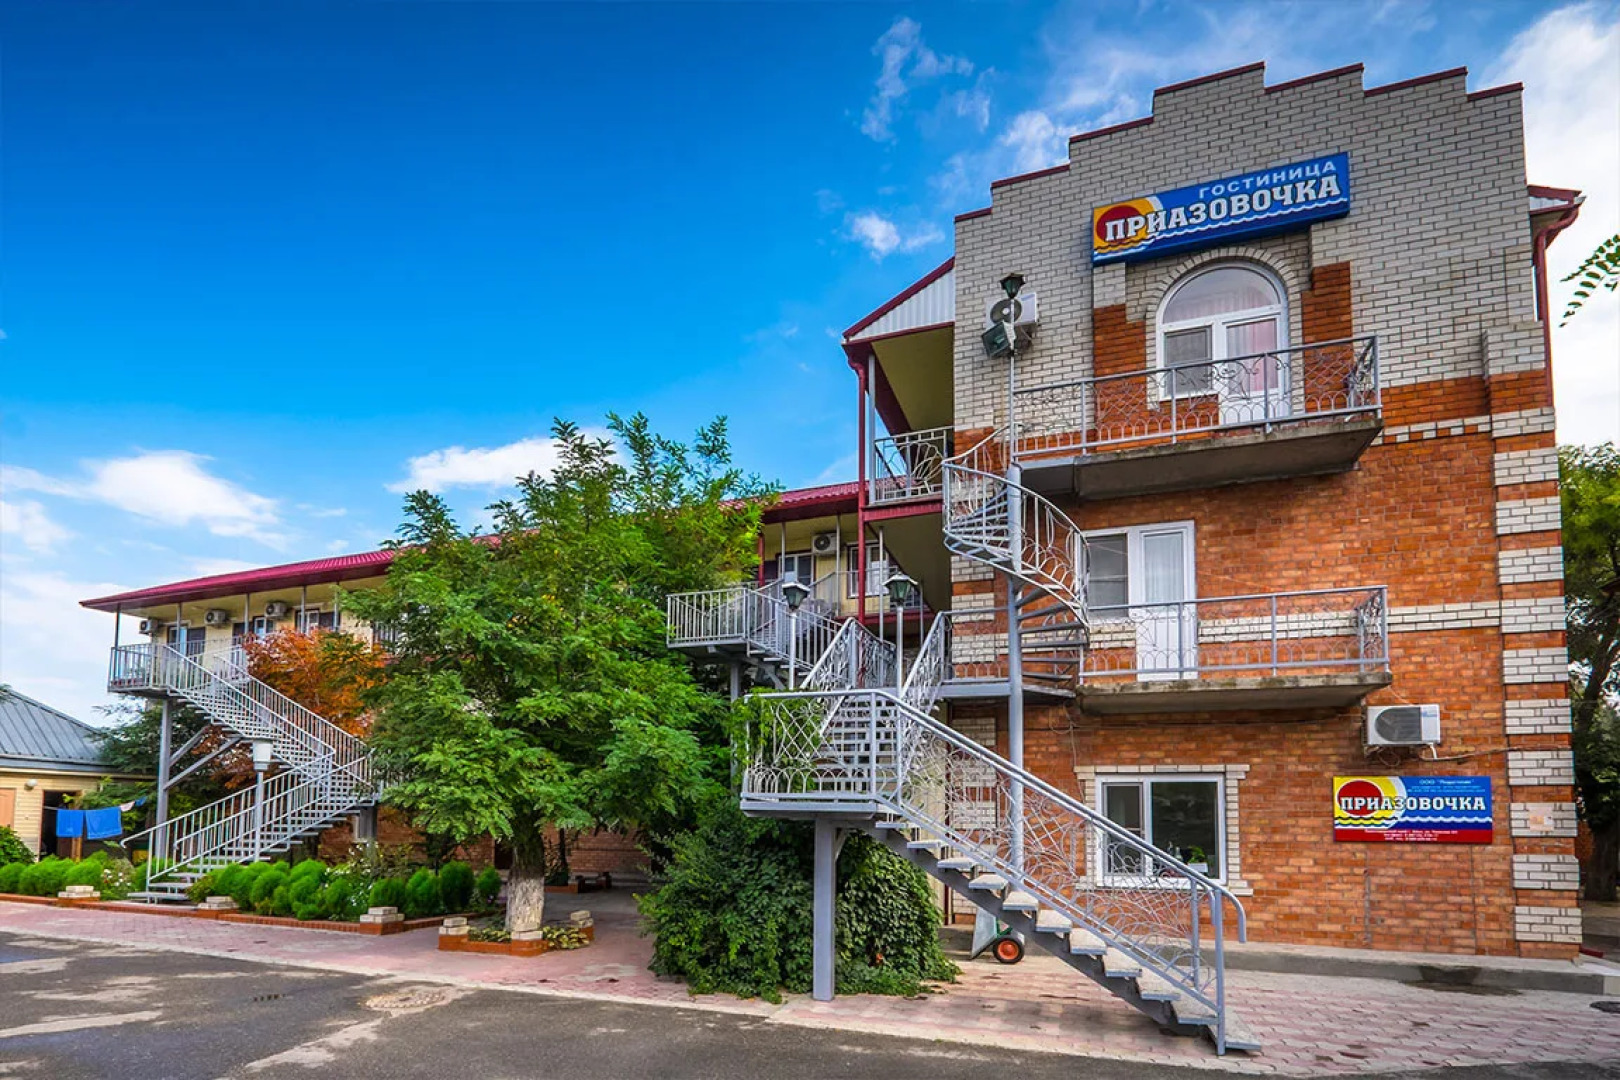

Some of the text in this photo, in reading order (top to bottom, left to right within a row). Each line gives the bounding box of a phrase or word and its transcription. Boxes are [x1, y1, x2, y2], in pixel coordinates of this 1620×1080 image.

[1199, 161, 1337, 198] ГОСТИНИЦА
[1104, 174, 1341, 242] ПРИАЗОВОЧКА
[1340, 796, 1486, 810] ПРИАЗОВОЧКА
